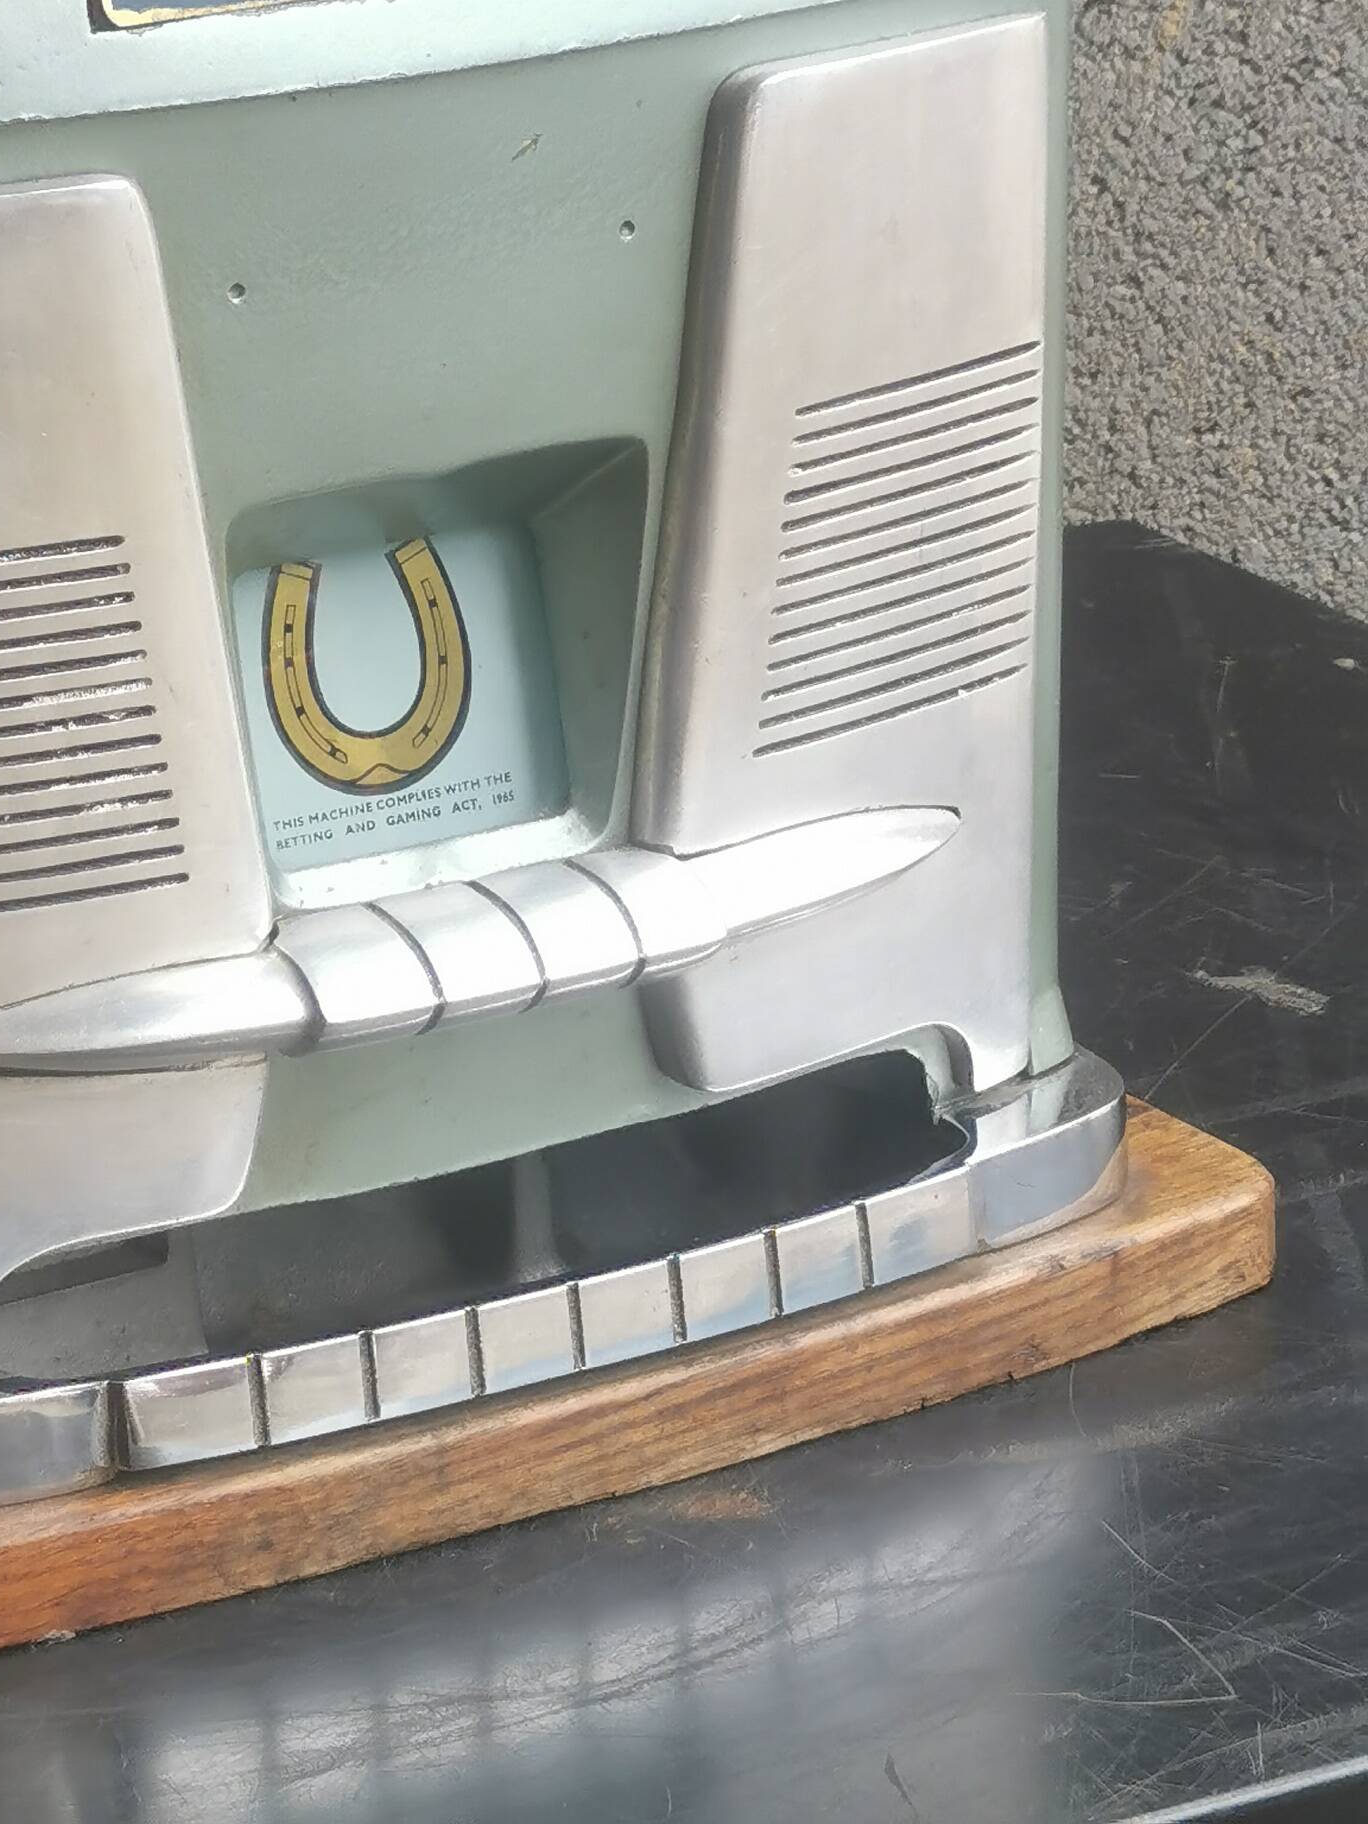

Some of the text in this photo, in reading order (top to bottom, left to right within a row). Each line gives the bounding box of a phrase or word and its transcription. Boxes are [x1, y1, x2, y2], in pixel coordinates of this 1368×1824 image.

[273, 772, 513, 831] THIS MACHINE COMPLIES WITH THE
[276, 829, 334, 850] BETTING
[345, 820, 376, 835] AND
[386, 806, 441, 826] GAMING
[452, 798, 482, 814] ACT,
